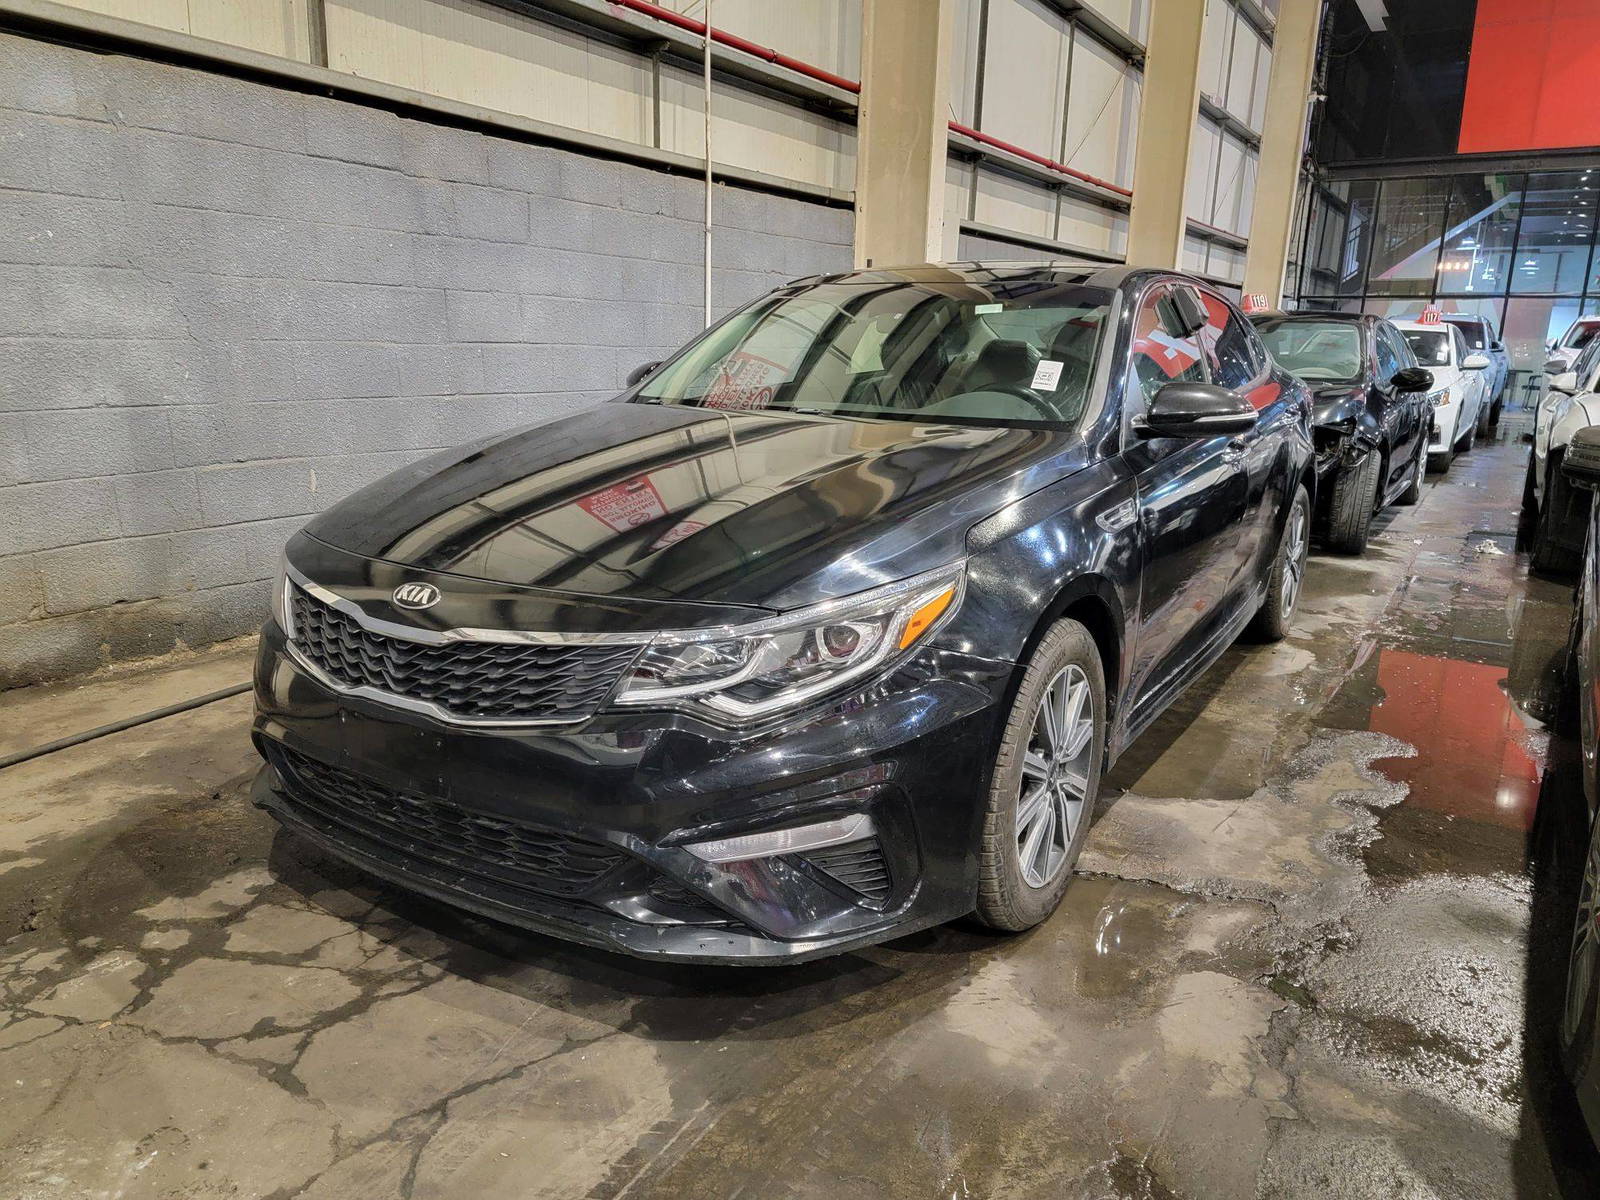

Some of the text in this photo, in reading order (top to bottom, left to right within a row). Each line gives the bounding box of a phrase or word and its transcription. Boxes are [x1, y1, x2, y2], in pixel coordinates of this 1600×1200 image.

[1251, 294, 1267, 308] 119
[1426, 312, 1439, 323] 117
[396, 584, 432, 605] KIA
